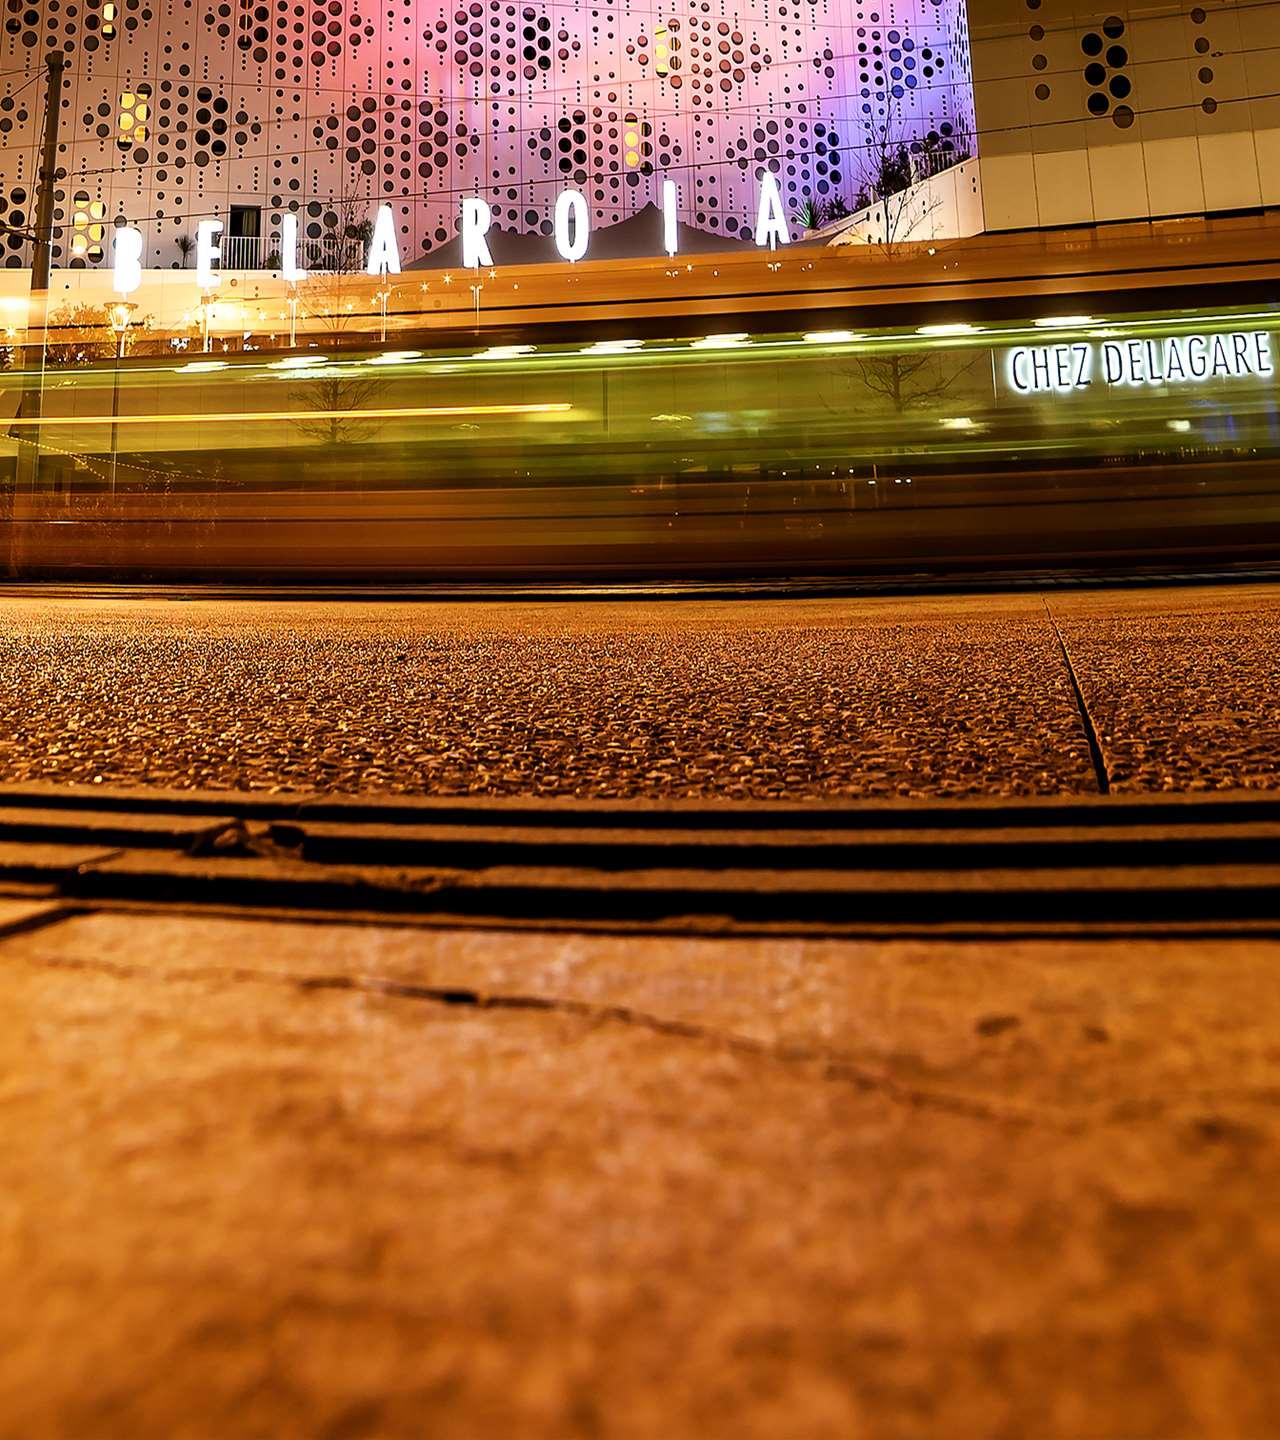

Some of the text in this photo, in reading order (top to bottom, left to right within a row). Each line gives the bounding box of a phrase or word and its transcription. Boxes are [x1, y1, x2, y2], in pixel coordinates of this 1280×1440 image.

[113, 170, 791, 293] BELAROIA
[1011, 331, 1272, 390] CHEZ DELAGARE
